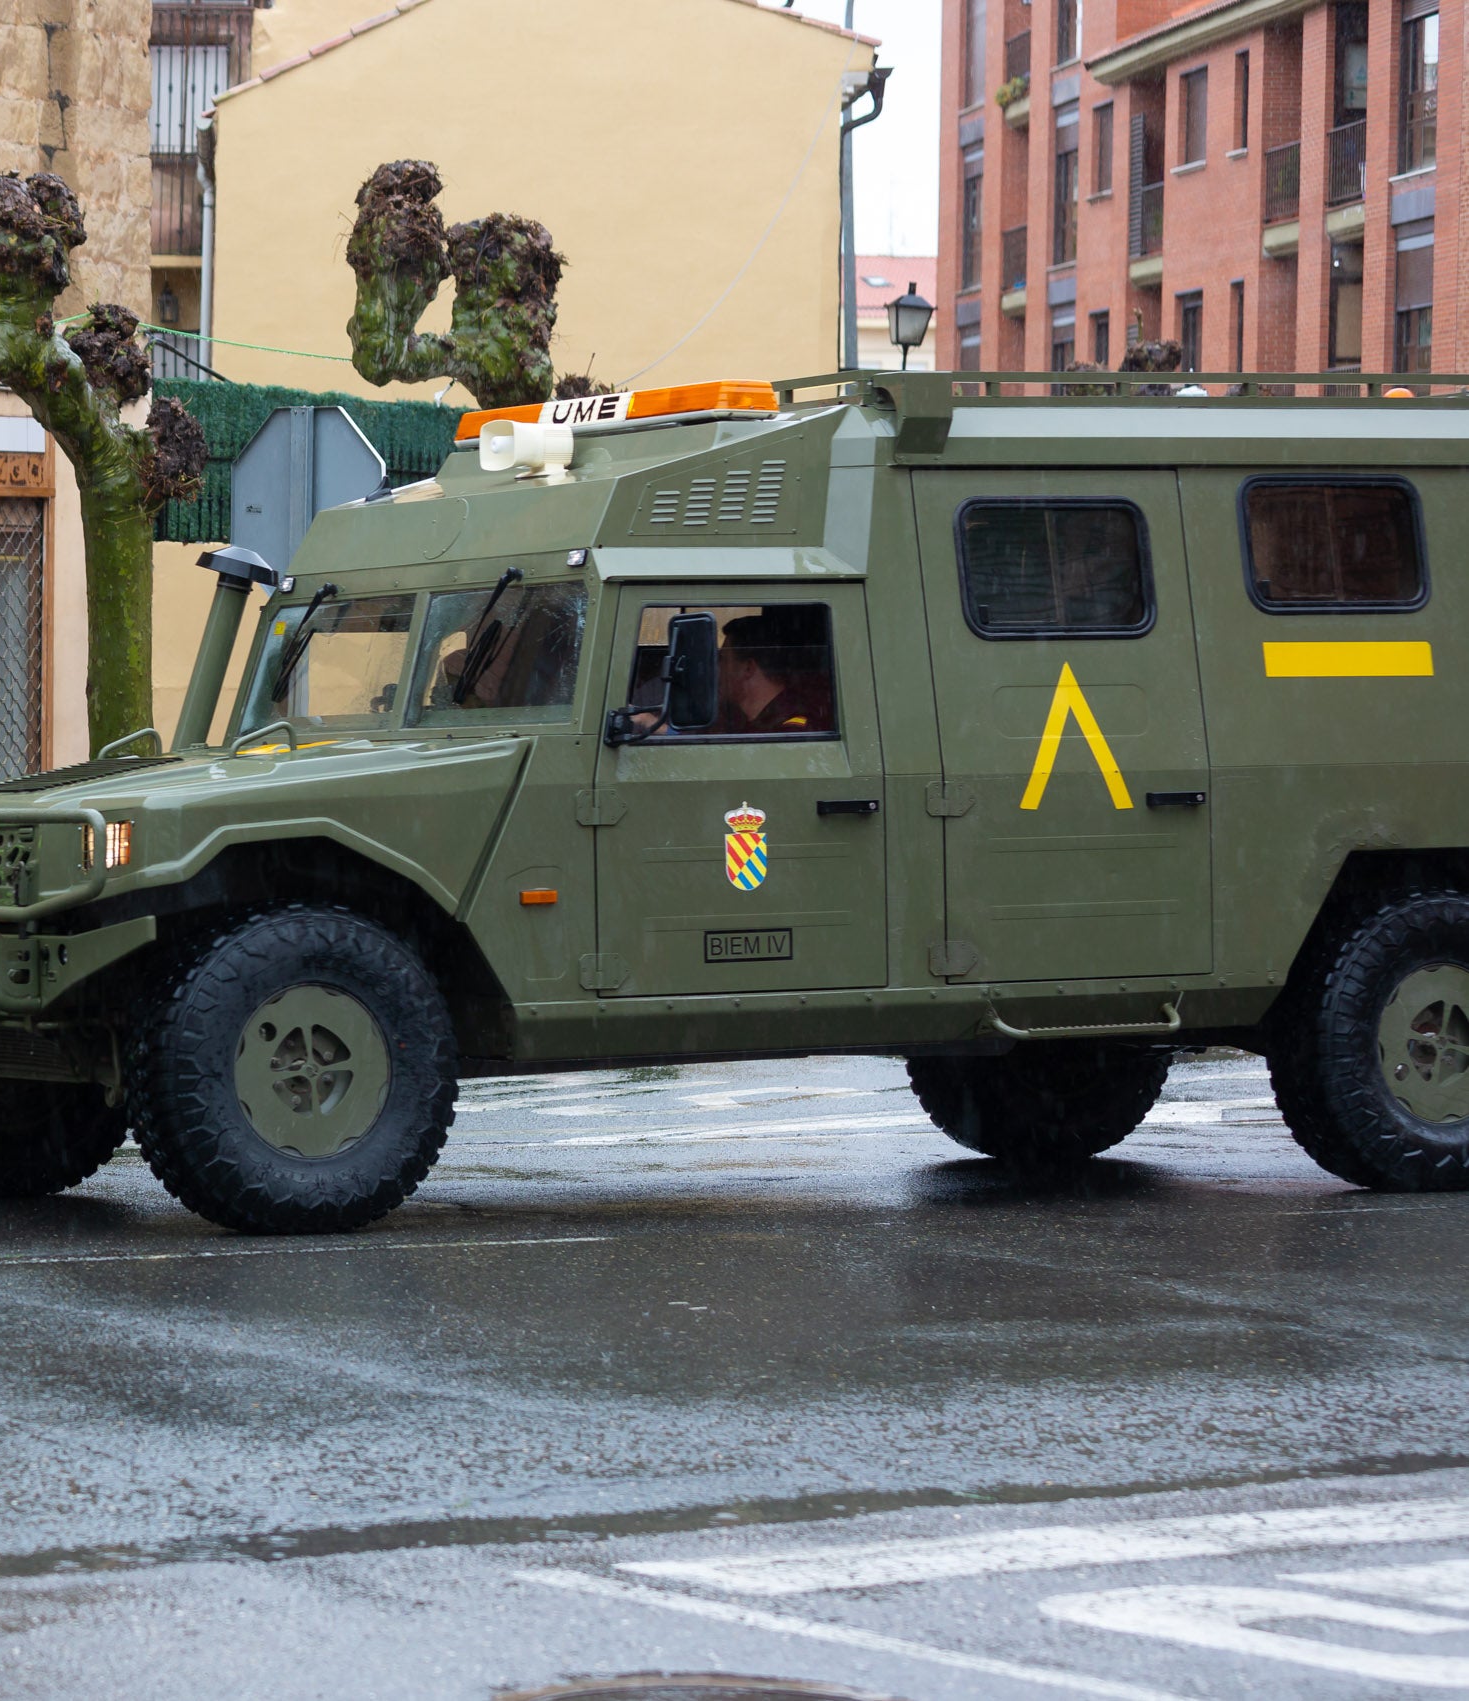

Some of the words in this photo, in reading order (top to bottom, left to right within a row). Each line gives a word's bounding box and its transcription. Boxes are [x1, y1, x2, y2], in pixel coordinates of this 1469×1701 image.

[553, 396, 620, 424] UME
[711, 935, 760, 956] BIEM
[767, 934, 787, 954] IV
